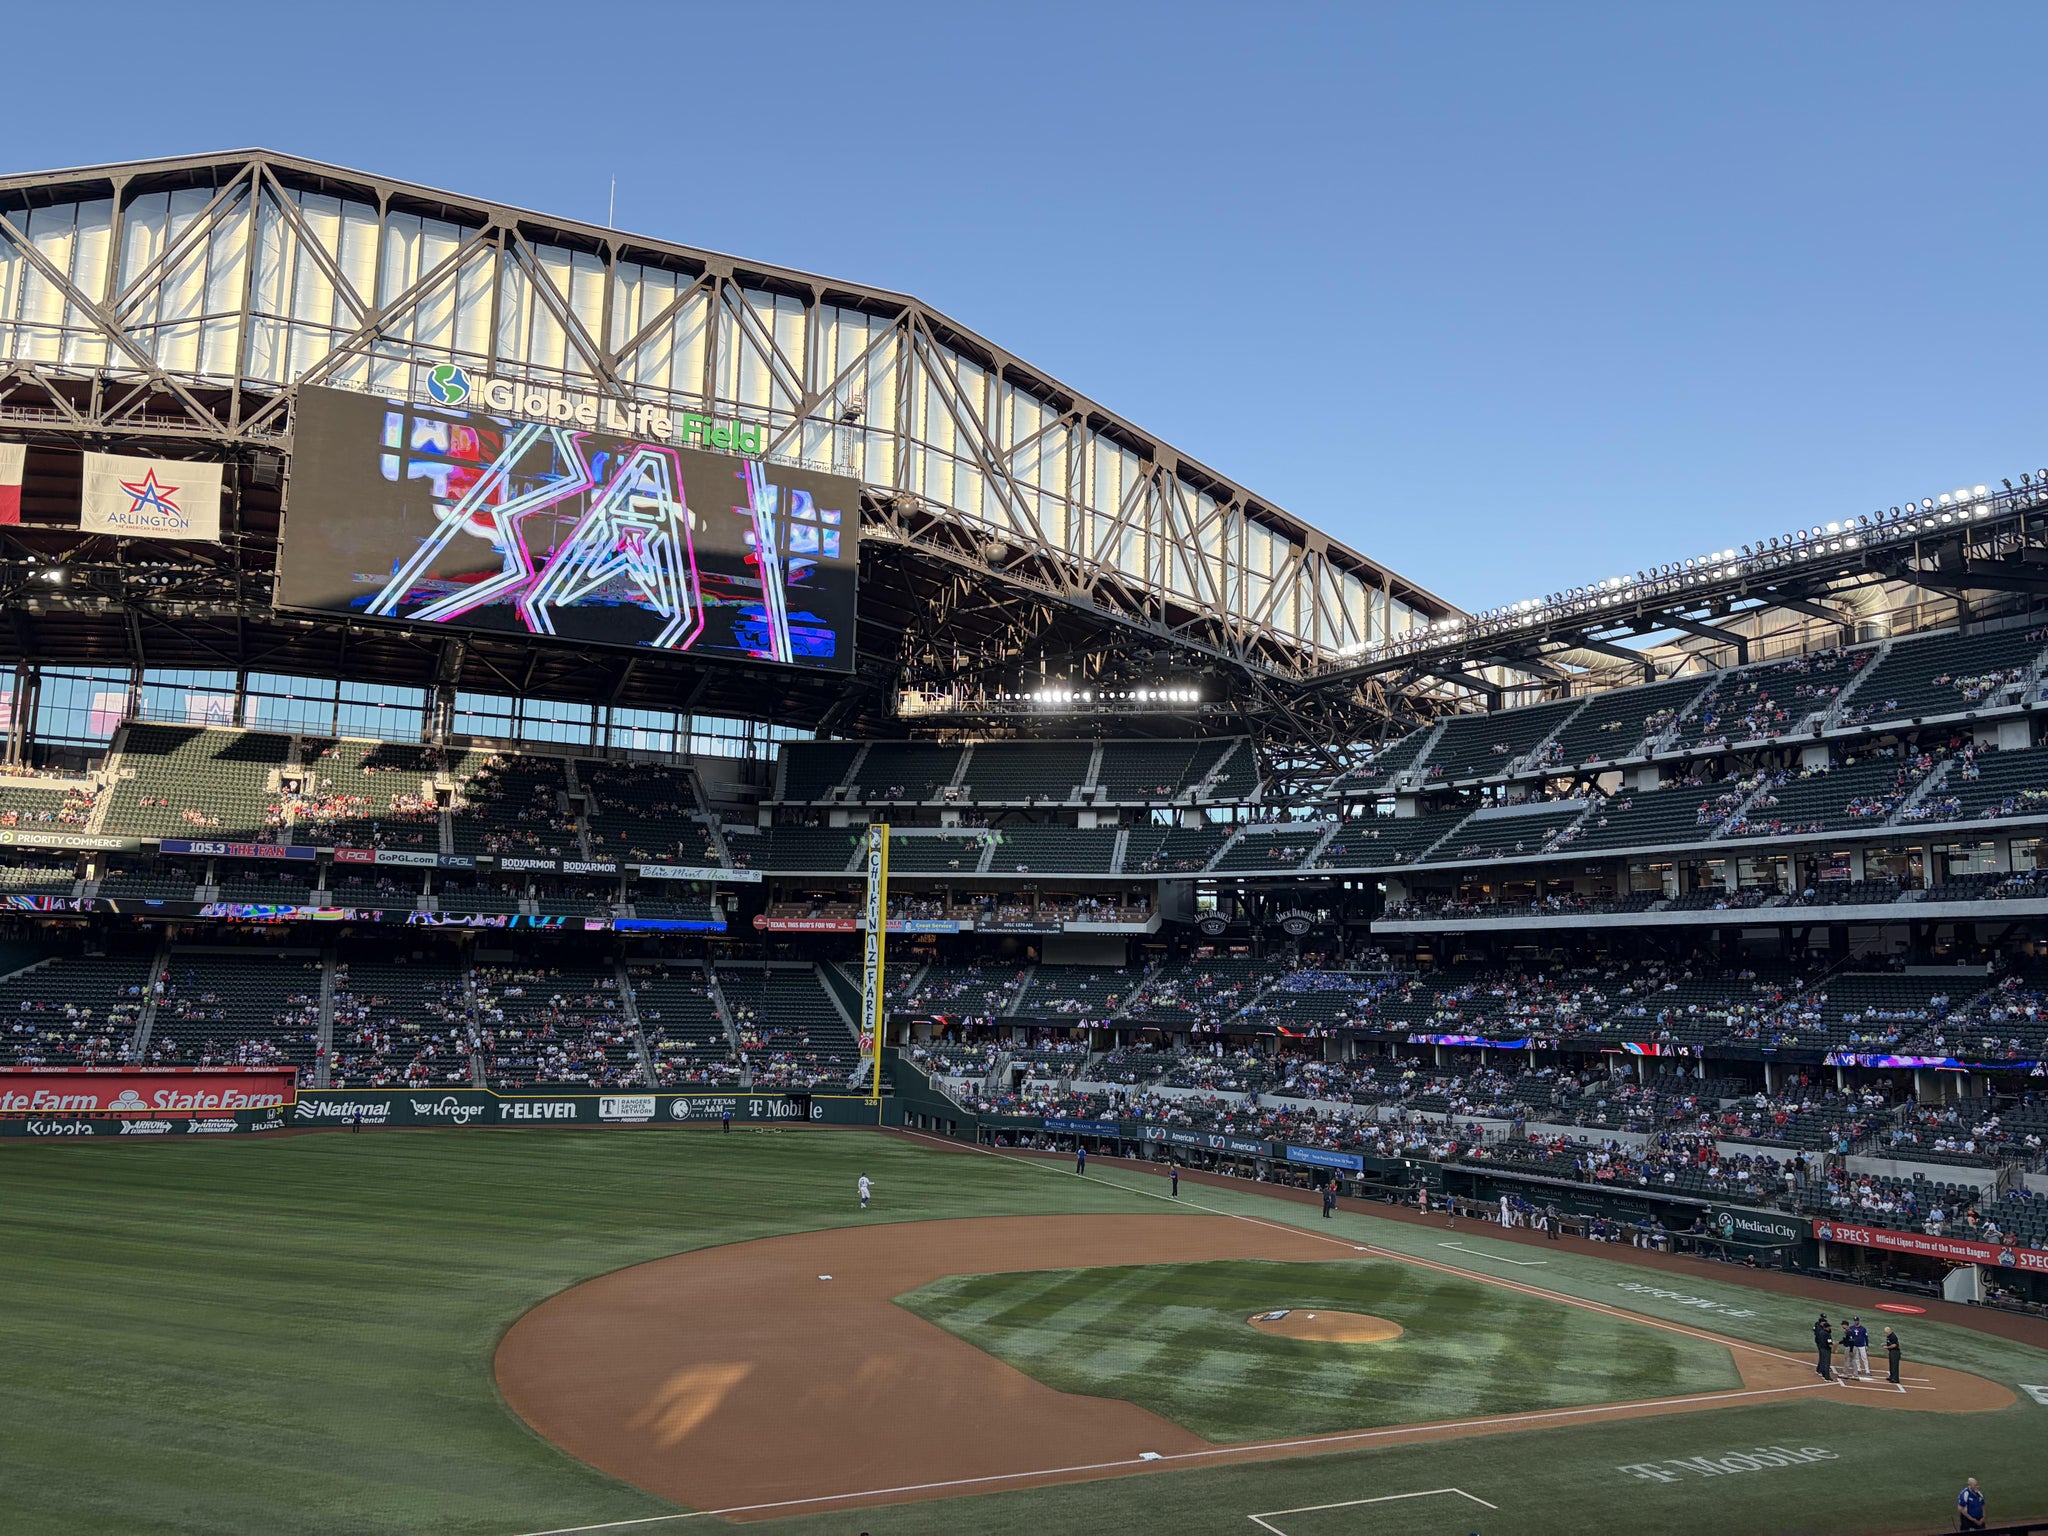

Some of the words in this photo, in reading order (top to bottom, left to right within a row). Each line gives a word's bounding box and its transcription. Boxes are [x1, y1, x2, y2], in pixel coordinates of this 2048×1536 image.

[484, 379, 597, 425] Globe
[607, 398, 672, 439] Life
[682, 412, 761, 454] Field
[107, 512, 189, 528] ARLINGTON
[17, 834, 65, 845] PRIORITY
[65, 837, 122, 848] COMMERCE
[189, 842, 225, 854] 105.3
[228, 843, 255, 855] THE
[257, 846, 286, 858] FAN
[346, 851, 372, 861] PGL
[378, 853, 434, 864] GoPGL.com
[448, 857, 473, 866] PGL
[501, 858, 556, 869] BODYARMOR
[563, 861, 616, 873] BODYARMOR
[641, 866, 669, 877] Blue
[670, 868, 704, 879] Mint
[705, 868, 731, 880] Thai
[868, 853, 880, 931] CHIKIN
[771, 921, 787, 929] TEXAS,
[864, 970, 875, 1026] FARE
[317, 1101, 389, 1116] National
[433, 1096, 485, 1124] Kroger
[27, 1121, 92, 1135] Kubota
[1171, 1132, 1195, 1143] American
[1230, 1141, 1257, 1152] American
[1735, 1218, 1775, 1234] Medical
[1775, 1225, 1797, 1240] City
[1837, 1227, 1870, 1243] SPEC'S
[1876, 1234, 1897, 1245] Official
[1897, 1238, 1914, 1249] Liquor
[1915, 1240, 1931, 1251] Store
[1931, 1243, 1938, 1251] of
[1938, 1243, 1949, 1253] the
[1949, 1244, 1966, 1255] Texas
[1966, 1246, 1990, 1259] Rangers
